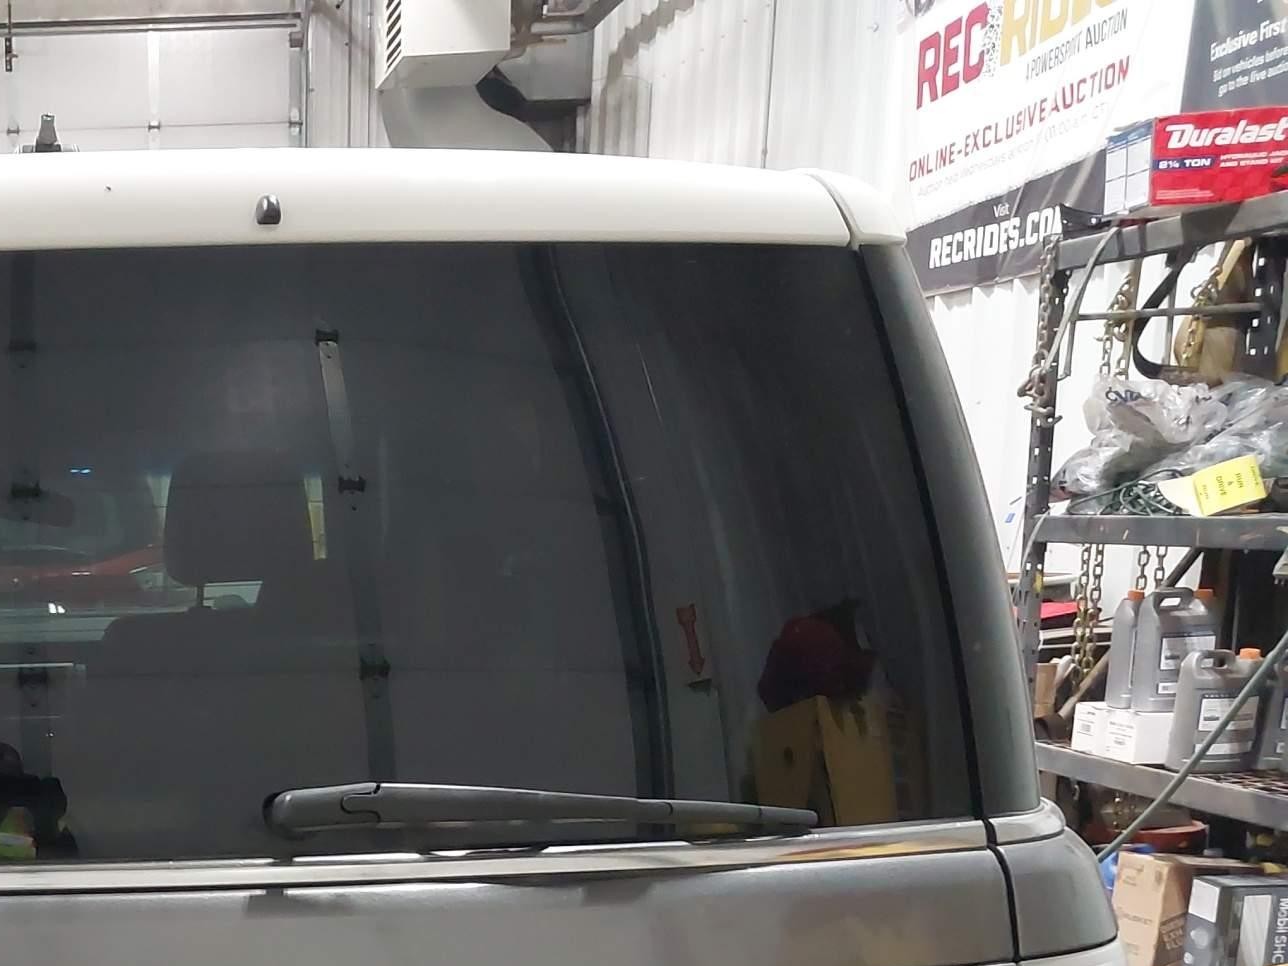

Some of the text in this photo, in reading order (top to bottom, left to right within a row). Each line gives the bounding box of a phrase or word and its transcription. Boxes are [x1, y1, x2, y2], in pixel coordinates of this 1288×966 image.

[1085, 8, 1128, 48] AUCTION
[916, 2, 989, 110] REC
[1210, 30, 1258, 62] Exclusive
[1049, 55, 1130, 113] AUCTION
[1165, 117, 1288, 149] Duralast
[1184, 158, 1212, 168] TON
[1271, 935, 1288, 965] SHC
